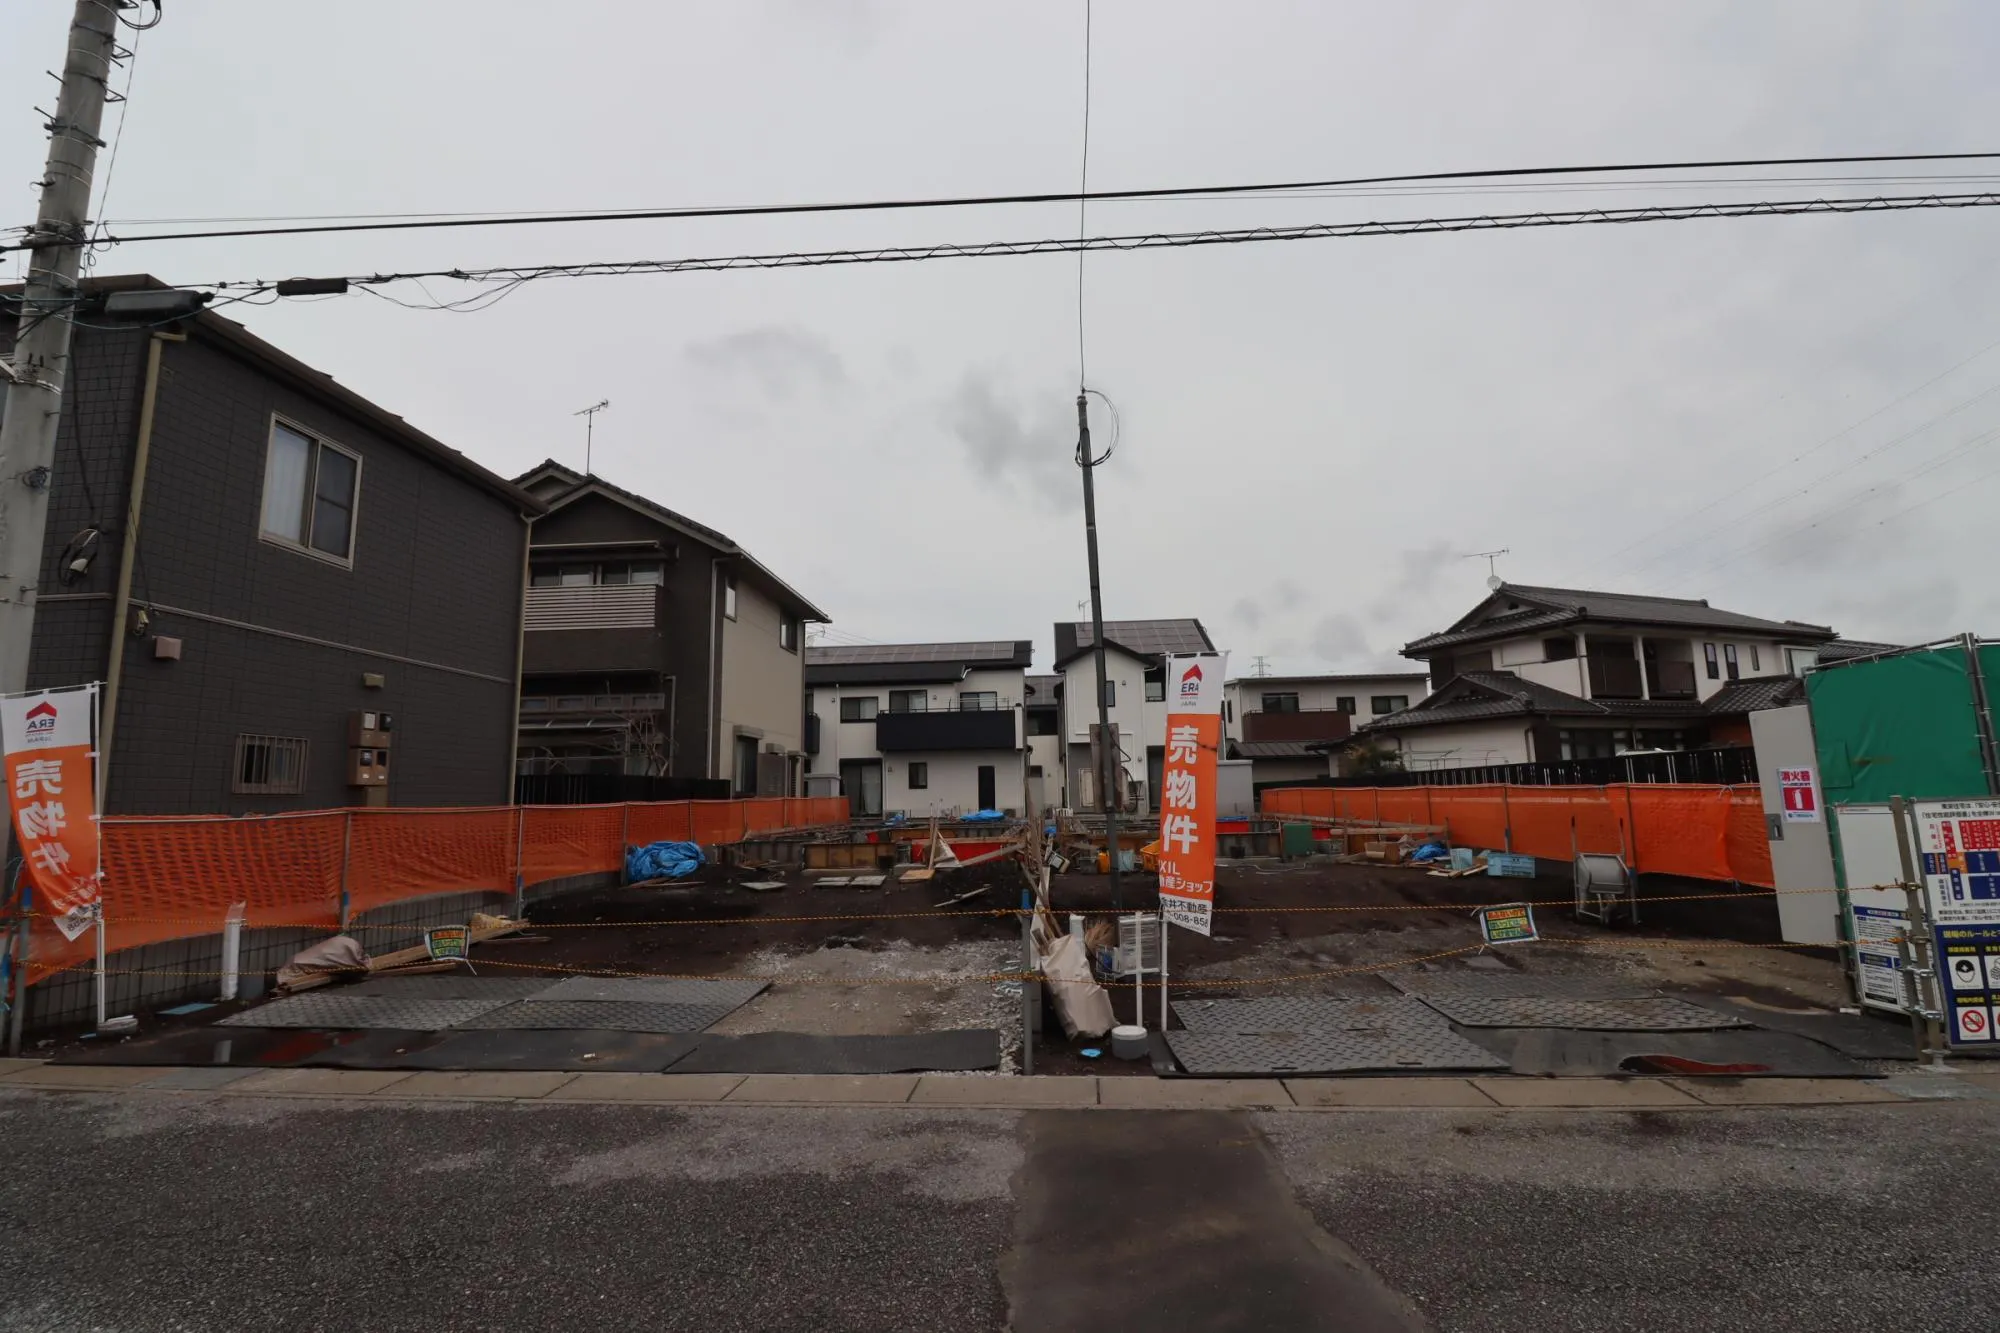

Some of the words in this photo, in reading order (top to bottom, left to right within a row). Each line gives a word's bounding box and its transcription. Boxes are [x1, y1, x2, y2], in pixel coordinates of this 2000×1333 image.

[1181, 682, 1199, 693] ERA
[1780, 770, 1811, 782] 消火器
[1164, 724, 1200, 856] 売物件
